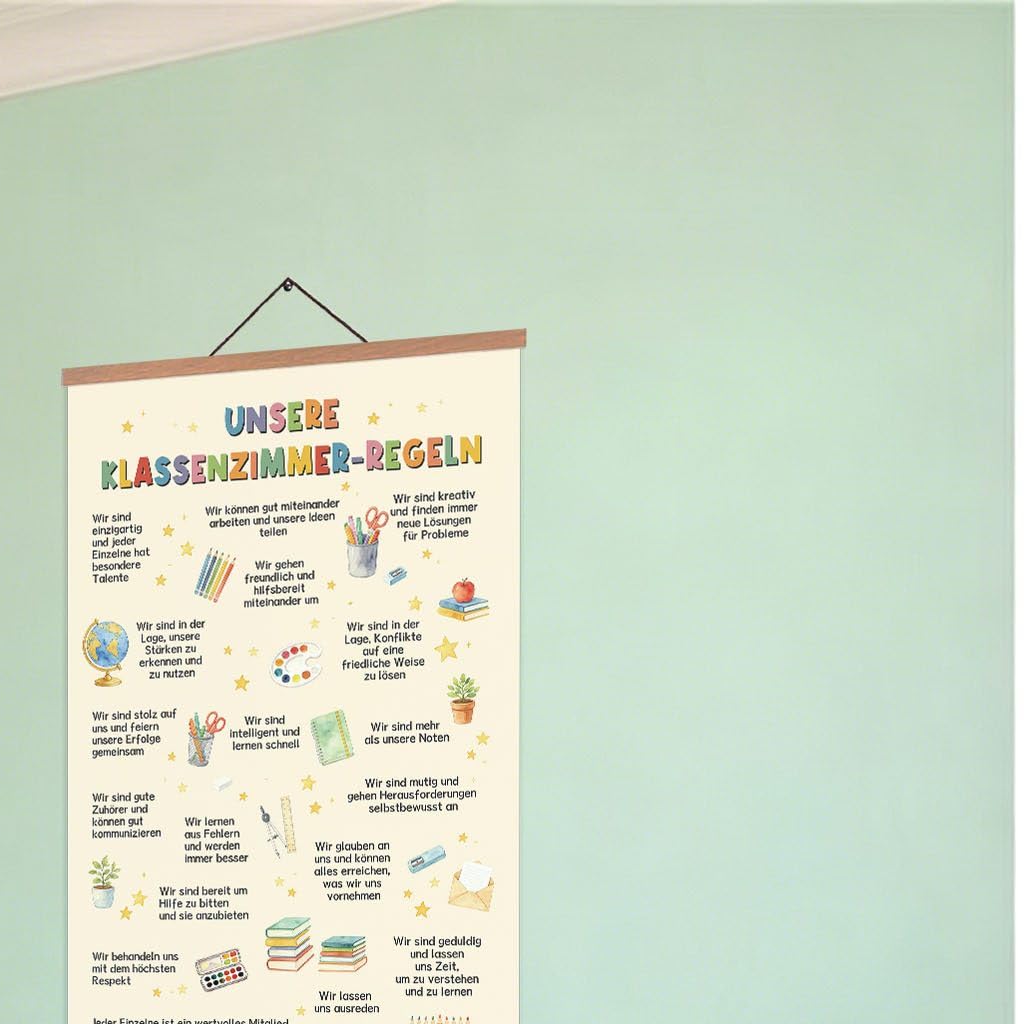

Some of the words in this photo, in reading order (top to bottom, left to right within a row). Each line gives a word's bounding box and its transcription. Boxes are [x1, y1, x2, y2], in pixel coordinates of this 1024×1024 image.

[224, 398, 340, 437] UNSERE
[101, 435, 483, 490] KLASSENZIMMER-REGELN
[393, 493, 411, 504] Wir
[414, 492, 435, 503] sind
[438, 490, 476, 501] kreativ
[390, 506, 408, 517] und
[412, 504, 444, 517] finden
[448, 504, 478, 513] immer
[92, 513, 109, 524] Wir
[111, 512, 131, 522] sind
[209, 517, 250, 528] arbeiten
[253, 515, 270, 525] und
[273, 515, 306, 524] unsere
[309, 512, 335, 522] Ideen
[397, 520, 421, 528] neue
[424, 517, 471, 527] Lösungen
[403, 531, 418, 542] für
[421, 528, 469, 540] Probleme
[92, 537, 109, 547] und
[111, 536, 136, 548] jeder
[92, 548, 131, 560] Einzelne
[134, 547, 150, 557] hat
[92, 560, 141, 572] besondere
[255, 560, 272, 570] Wir
[275, 559, 304, 571] gehen
[92, 573, 129, 583] Talente
[244, 571, 294, 584] freundlich
[297, 570, 315, 580] und
[244, 596, 302, 608] miteinander
[305, 597, 319, 605] um
[136, 621, 153, 631] Wir
[156, 620, 175, 631] sind
[178, 620, 187, 629] in
[189, 619, 205, 629] der
[347, 622, 364, 632] Wir
[368, 620, 388, 631] sind
[391, 620, 401, 630] in
[403, 619, 420, 629] der
[169, 633, 200, 642] unsere
[374, 632, 422, 643] Konflikte
[145, 644, 182, 655] Stärken
[362, 645, 380, 657] auf
[382, 645, 404, 655] eine
[139, 657, 182, 667] erkennen
[185, 655, 202, 665] und
[342, 658, 391, 670] friedliche
[394, 657, 425, 667] Weise
[149, 671, 160, 679] zu
[163, 669, 195, 678] nutzen
[364, 673, 376, 681] zu
[378, 670, 406, 680] lösen
[92, 711, 109, 721] Wir
[111, 710, 131, 720] sind
[134, 709, 158, 720] stolz
[160, 708, 177, 719] auf
[244, 716, 262, 725] Wir
[265, 715, 285, 725] sind
[92, 725, 108, 733] uns
[110, 722, 127, 732] und
[130, 722, 159, 733] feiern
[370, 722, 388, 732] Wir
[391, 721, 412, 731] sind
[415, 720, 440, 731] mehr
[92, 737, 123, 745] unsere
[125, 734, 161, 745] Erfolge
[364, 735, 380, 745] als
[382, 735, 416, 744] unsere
[419, 733, 450, 743] Noten
[232, 741, 263, 751] lernen
[265, 739, 300, 750] schnell
[365, 778, 383, 788] Wir
[385, 777, 407, 788] sind
[409, 777, 438, 788] mutig
[440, 776, 459, 786] und
[92, 793, 109, 802] Wir
[111, 792, 131, 802] sind
[134, 792, 155, 803] gute
[347, 791, 377, 803] gehen
[379, 789, 477, 801] Herausforderungen
[92, 805, 128, 815] Zuhörer
[131, 804, 148, 814] und
[369, 802, 443, 813] selbstbewusst
[445, 803, 459, 811] an
[92, 817, 125, 827] können
[128, 816, 143, 827] gut
[185, 817, 202, 827] Wir
[205, 817, 235, 826] lernen
[92, 829, 161, 839] kommunizieren
[204, 829, 240, 839] Fehlern
[184, 841, 202, 851] und
[205, 840, 240, 851] werden
[315, 841, 333, 852] Wir
[335, 841, 375, 853] glauben
[377, 842, 390, 850] an
[314, 856, 331, 864] uns
[334, 853, 352, 863] und
[354, 853, 391, 863] können
[314, 866, 338, 876] alles
[322, 881, 343, 889] was
[346, 878, 362, 888] wir
[365, 880, 382, 888] uns
[159, 886, 176, 896] Wir
[179, 886, 199, 896] sind
[202, 886, 231, 896] bereit
[327, 891, 381, 901] vornehmen
[159, 911, 176, 920] und
[179, 911, 193, 920] sie
[196, 910, 249, 920] anzubieten
[393, 936, 411, 946] Wir
[414, 936, 436, 946] sind
[438, 936, 482, 948] geduldig
[410, 948, 428, 959] und
[431, 949, 465, 959] lassen
[92, 964, 107, 973] mit
[110, 964, 130, 973] dem
[132, 963, 176, 973] höchsten
[415, 963, 432, 972] uns
[92, 975, 131, 987] Respekt
[395, 976, 410, 984] um
[413, 976, 425, 984] zu
[428, 974, 479, 984] verstehen
[318, 991, 337, 1001] Wir
[339, 991, 372, 1001] lassen
[405, 986, 423, 997] und
[426, 988, 438, 997] zu
[441, 986, 473, 997] lernen
[314, 1005, 331, 1013] uns
[333, 1003, 380, 1013] ausreden
